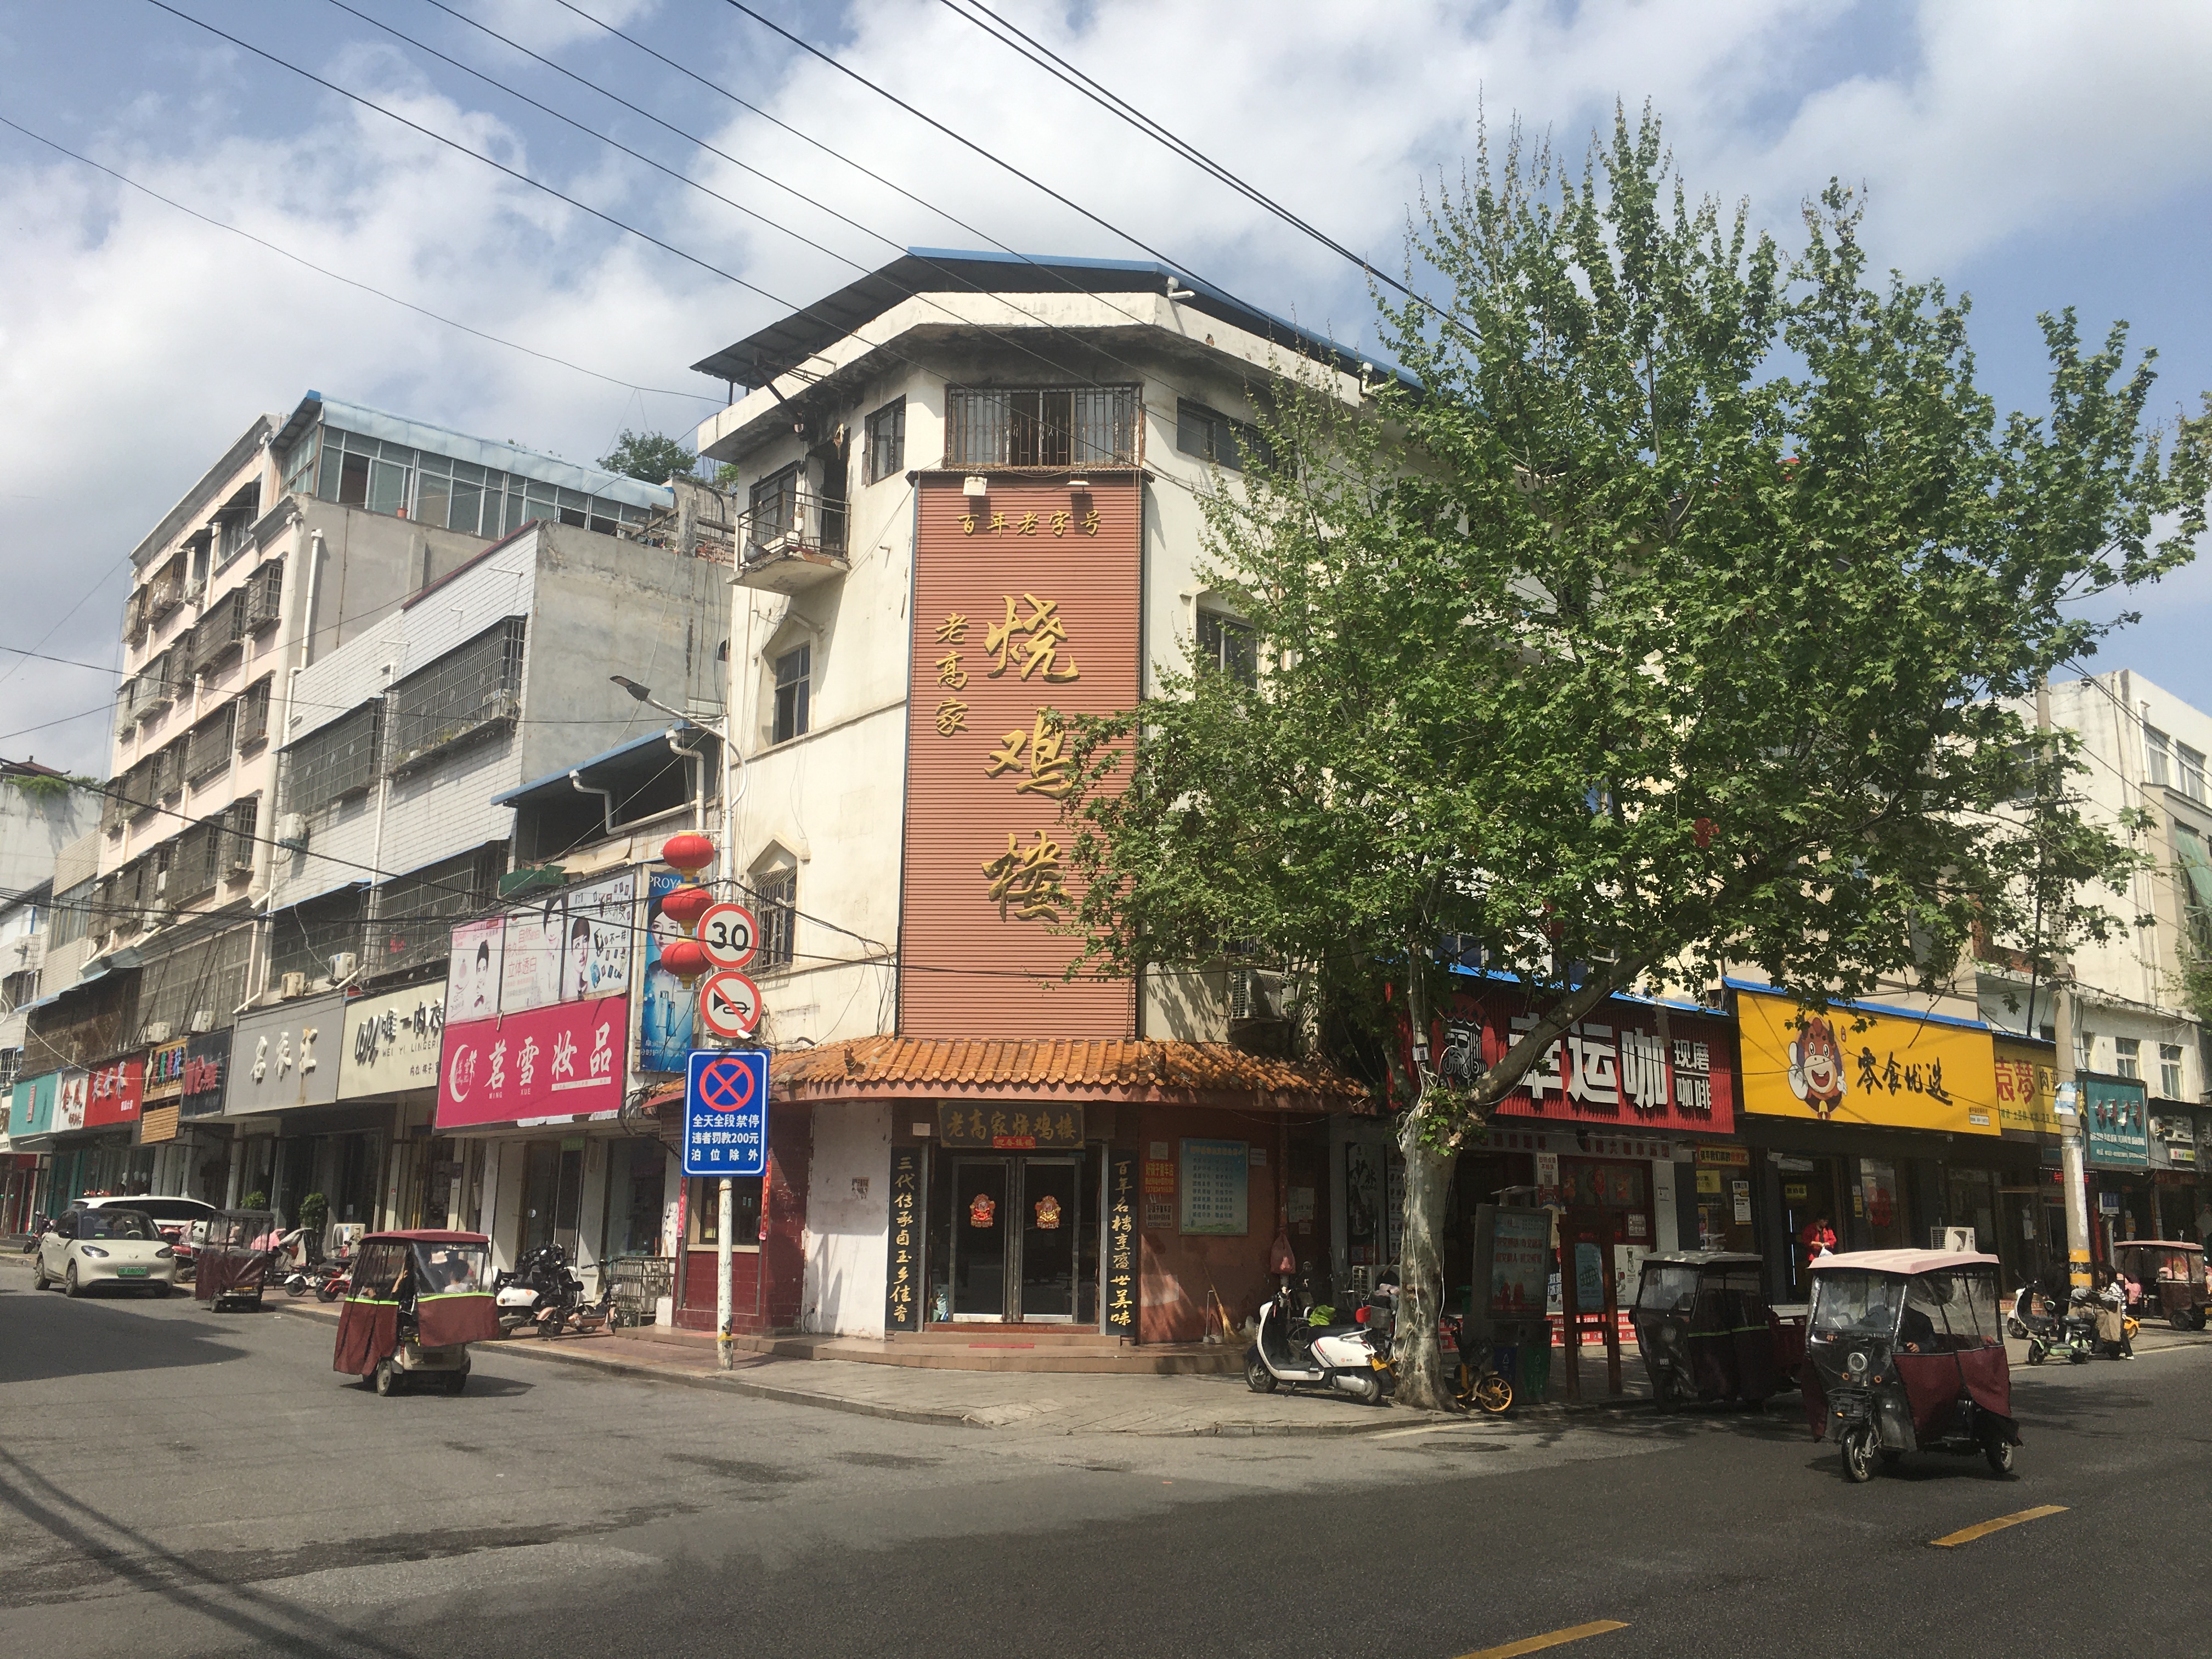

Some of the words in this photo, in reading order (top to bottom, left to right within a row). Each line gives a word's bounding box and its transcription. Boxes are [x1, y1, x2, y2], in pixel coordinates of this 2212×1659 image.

[957, 510, 1102, 537] 百年老字号
[935, 613, 969, 737] 老高家
[981, 592, 1080, 923] 烧鸡楼
[711, 922, 749, 952] 30
[484, 1022, 612, 1090] 茗雪妆品
[1509, 1013, 1668, 1108] 幸运咖
[1674, 1039, 1711, 1071] 现磨
[1857, 1047, 1953, 1106] 零食优选
[489, 1091, 503, 1099] MING
[1677, 1077, 1712, 1110] 咖啡
[692, 1114, 760, 1128] 全天全段禁停
[947, 1108, 1076, 1141] 老高家烧鸡楼
[692, 1131, 759, 1144] 违者罚款200元
[691, 1148, 758, 1161] 泊位除外
